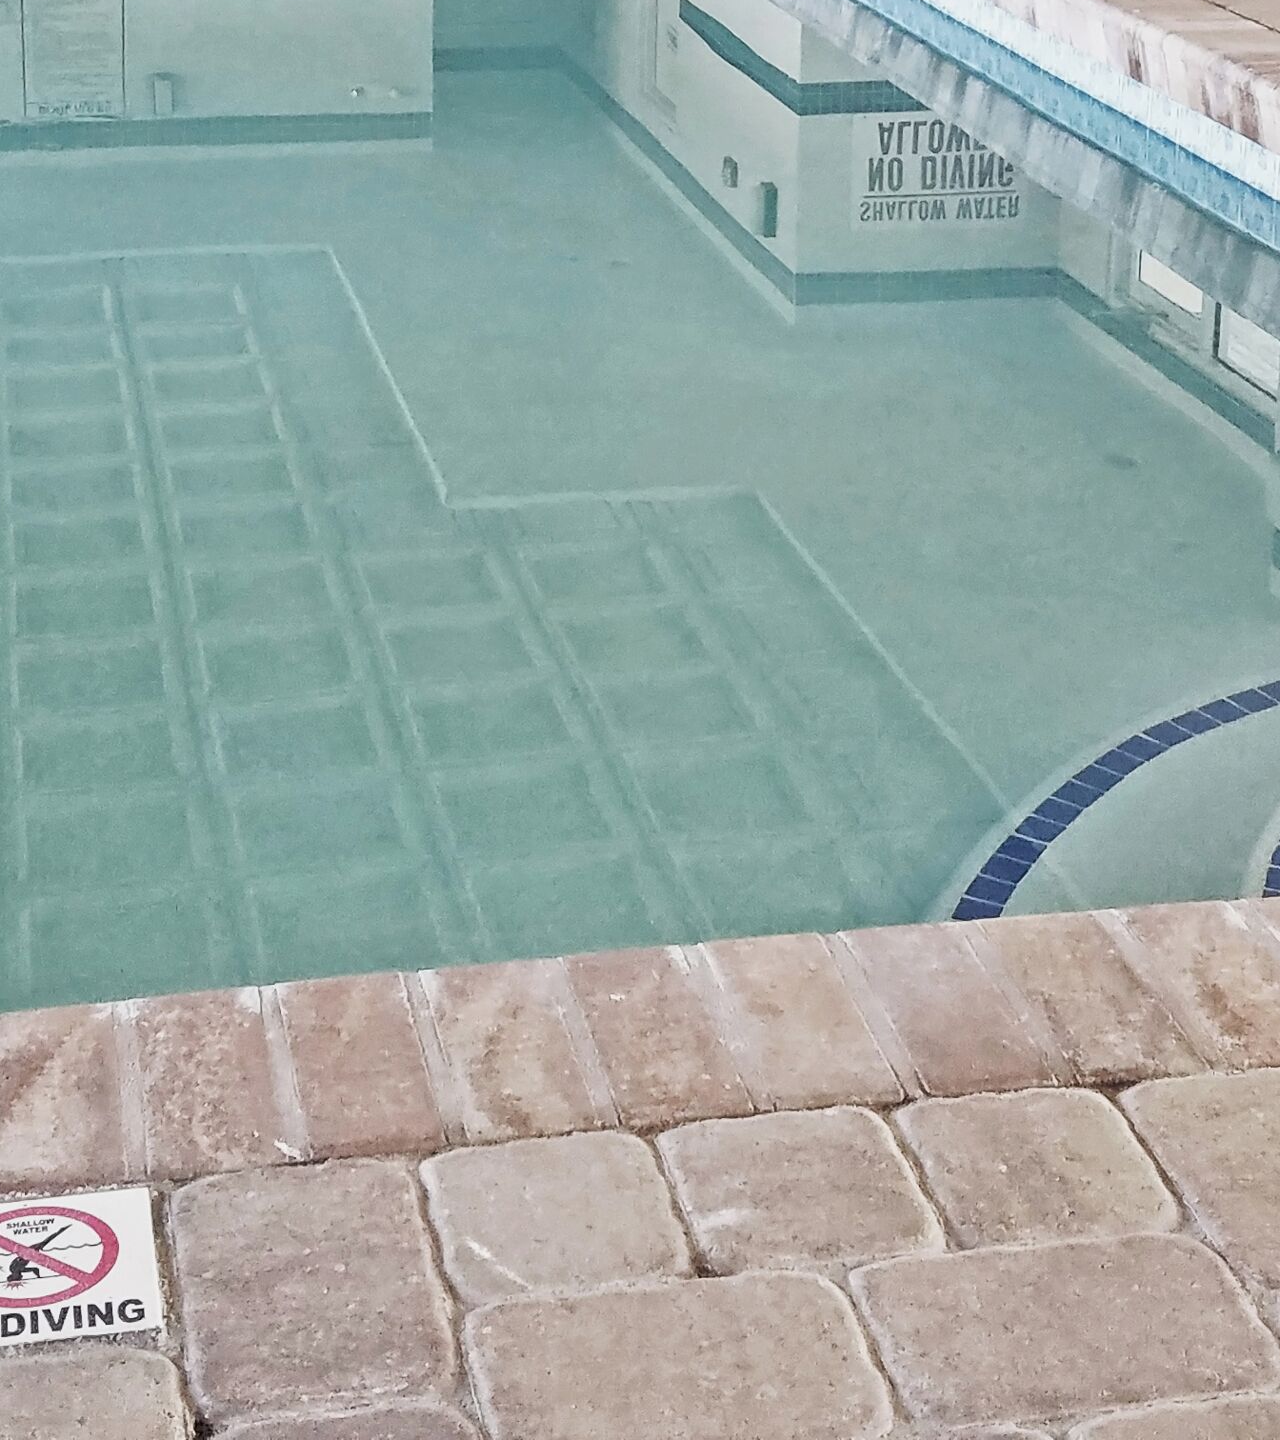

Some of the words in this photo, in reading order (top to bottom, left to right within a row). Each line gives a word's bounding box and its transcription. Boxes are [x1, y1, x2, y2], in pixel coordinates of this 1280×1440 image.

[6, 1218, 55, 1229] SHALLOW
[13, 1226, 49, 1236] WATER
[1, 1299, 145, 1337] DIVING
